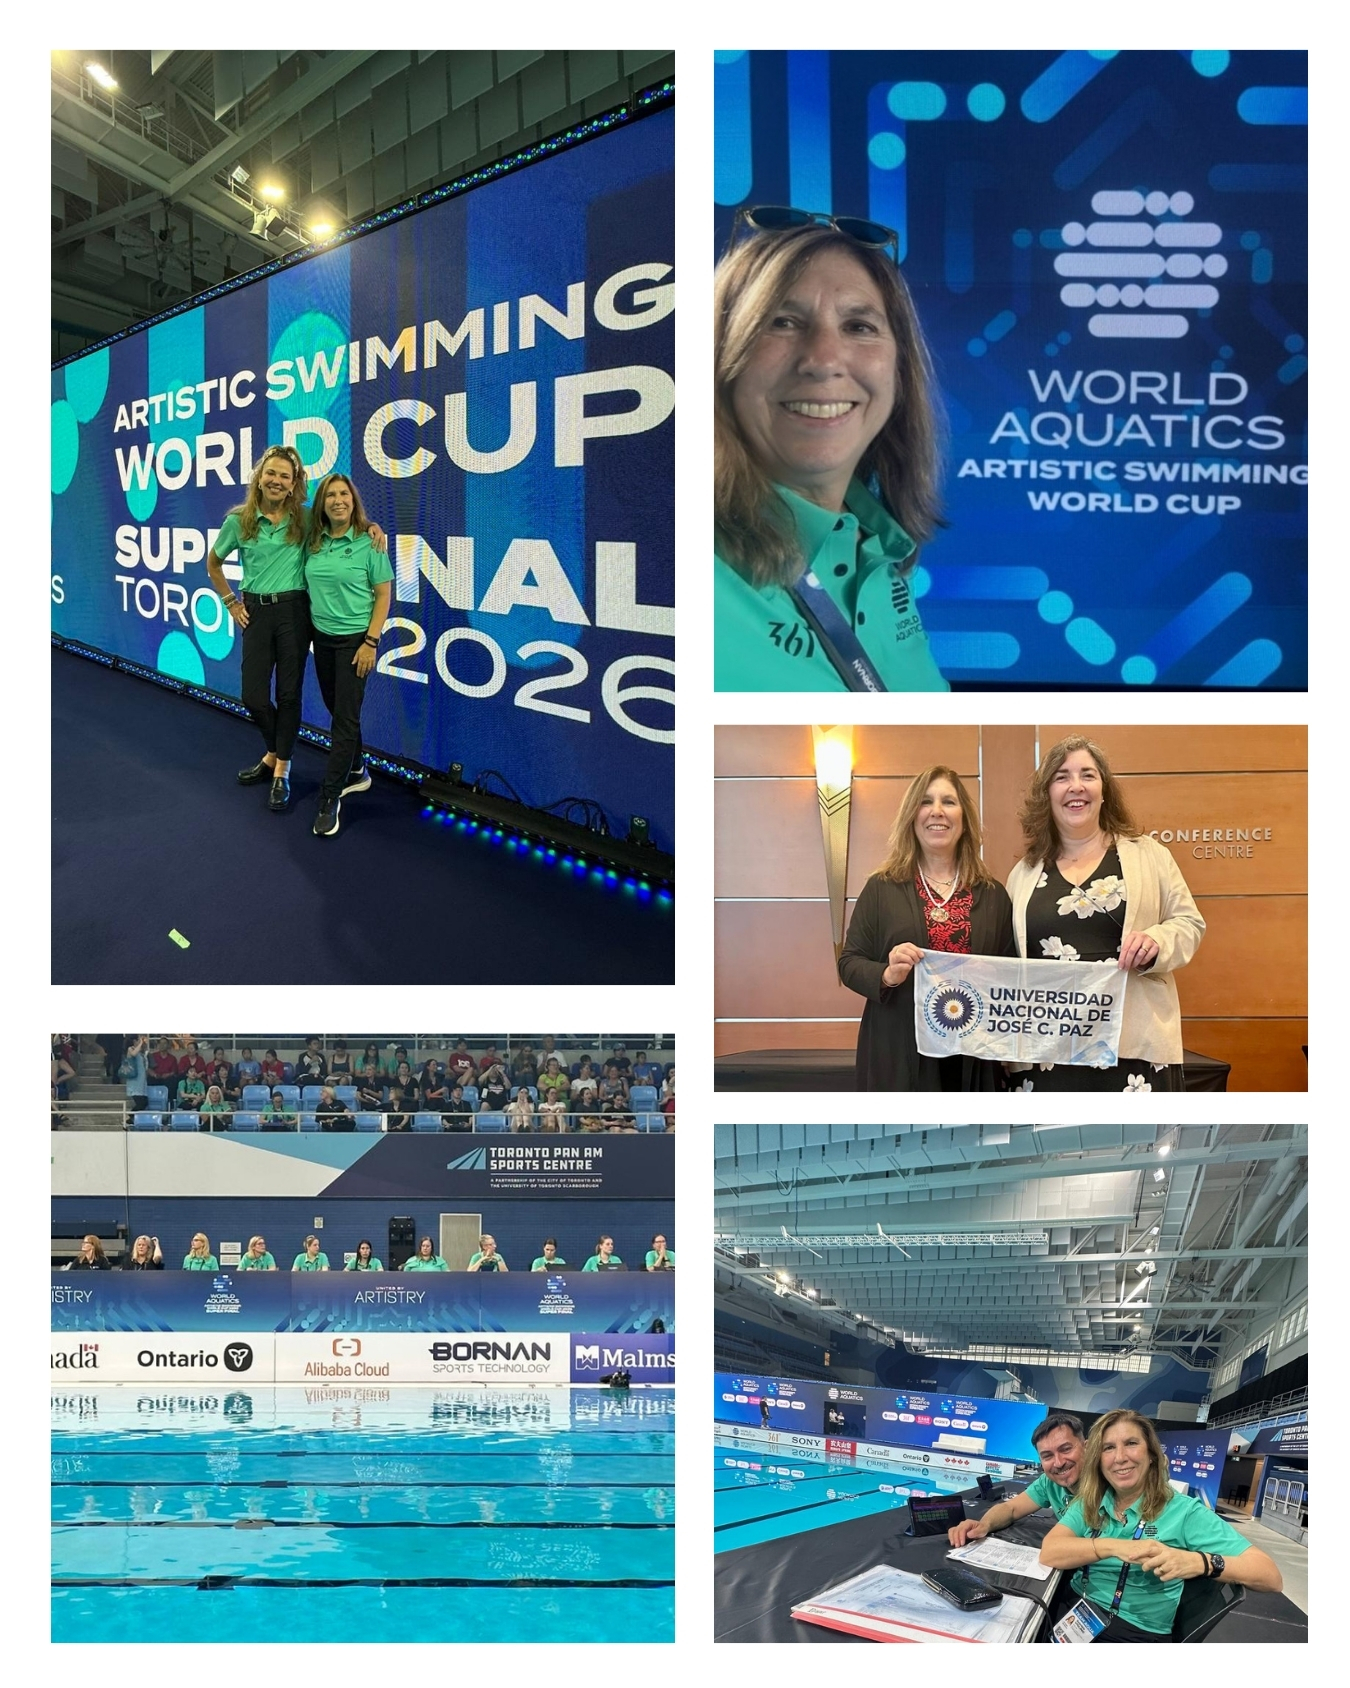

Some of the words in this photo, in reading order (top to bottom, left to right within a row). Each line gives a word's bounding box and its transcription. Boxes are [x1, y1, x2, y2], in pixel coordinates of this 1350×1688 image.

[114, 370, 256, 433] ARTISTIC
[265, 262, 675, 400] SWIMMING
[1027, 369, 1249, 406] WORLD
[114, 416, 339, 492] WORLD
[363, 365, 675, 479] CUP
[989, 411, 1286, 450] AQUATICS
[956, 459, 1116, 482] ARTISTIC
[1124, 461, 1308, 486] SWIMMING
[1027, 491, 1158, 514] WORLD
[1166, 494, 1242, 515] CUP
[895, 615, 920, 631] WORLD
[376, 617, 675, 744] 2026
[1149, 828, 1272, 842] CONFERENCE
[1192, 845, 1254, 859] CENTRE
[990, 988, 1114, 1006] UNIVERSIDAD
[988, 1004, 1082, 1021] NACIONAL
[1088, 1009, 1110, 1022] DE
[986, 1018, 1032, 1034] JOSÉ
[1037, 1022, 1054, 1036] C.
[1059, 1024, 1094, 1036] PAZ
[490, 1147, 550, 1158] TORONTO
[554, 1147, 580, 1158] PAN
[584, 1148, 603, 1158] AM
[490, 1160, 539, 1170] SPORTS
[543, 1160, 592, 1170] CENTRE
[354, 1291, 426, 1303] ARTISTRY
[137, 1350, 218, 1367] Ontario
[430, 1342, 550, 1361] BORNAN
[602, 1349, 675, 1368] Malms
[304, 1362, 351, 1376] Alibaba
[354, 1362, 390, 1376] Cloud
[433, 1364, 474, 1373] SPORTS
[478, 1363, 550, 1374] TECHNOLOGY
[792, 1436, 821, 1446] SONY
[867, 1447, 890, 1457] Canada
